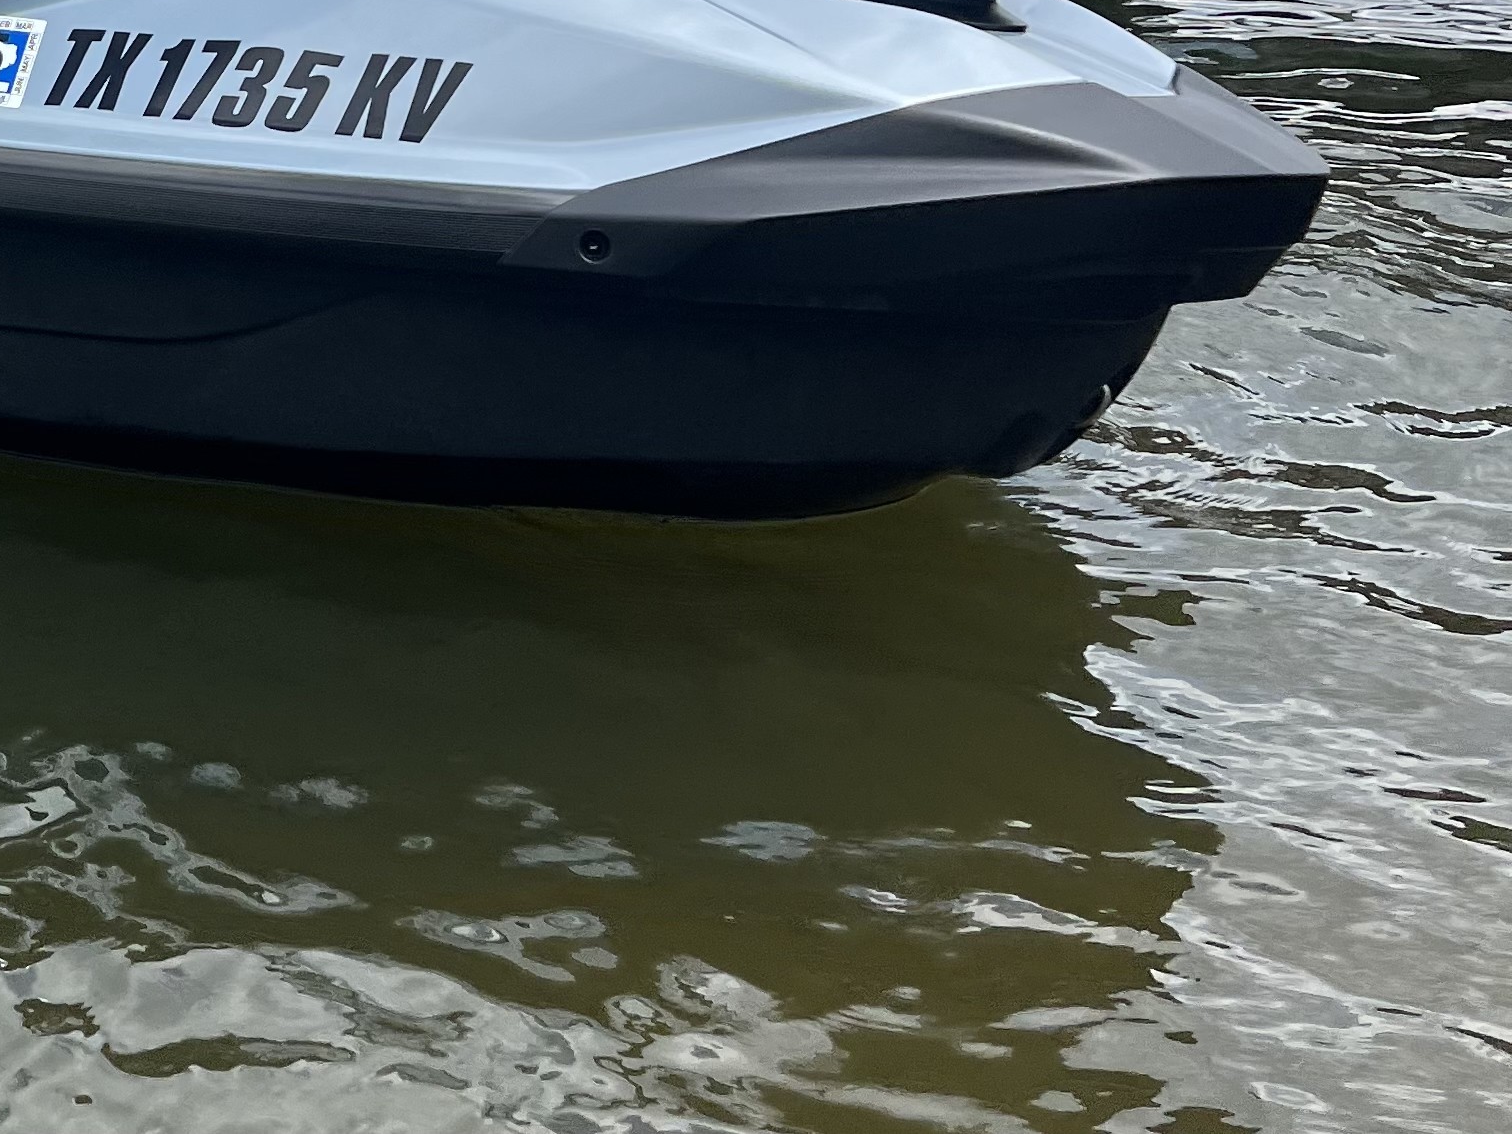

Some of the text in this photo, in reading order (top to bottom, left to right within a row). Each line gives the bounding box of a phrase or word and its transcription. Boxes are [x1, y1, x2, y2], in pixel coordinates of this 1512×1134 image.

[16, 21, 34, 30] MAR
[28, 33, 38, 50] APR
[21, 55, 31, 73] MAY
[44, 29, 474, 144] TX 1735 KV
